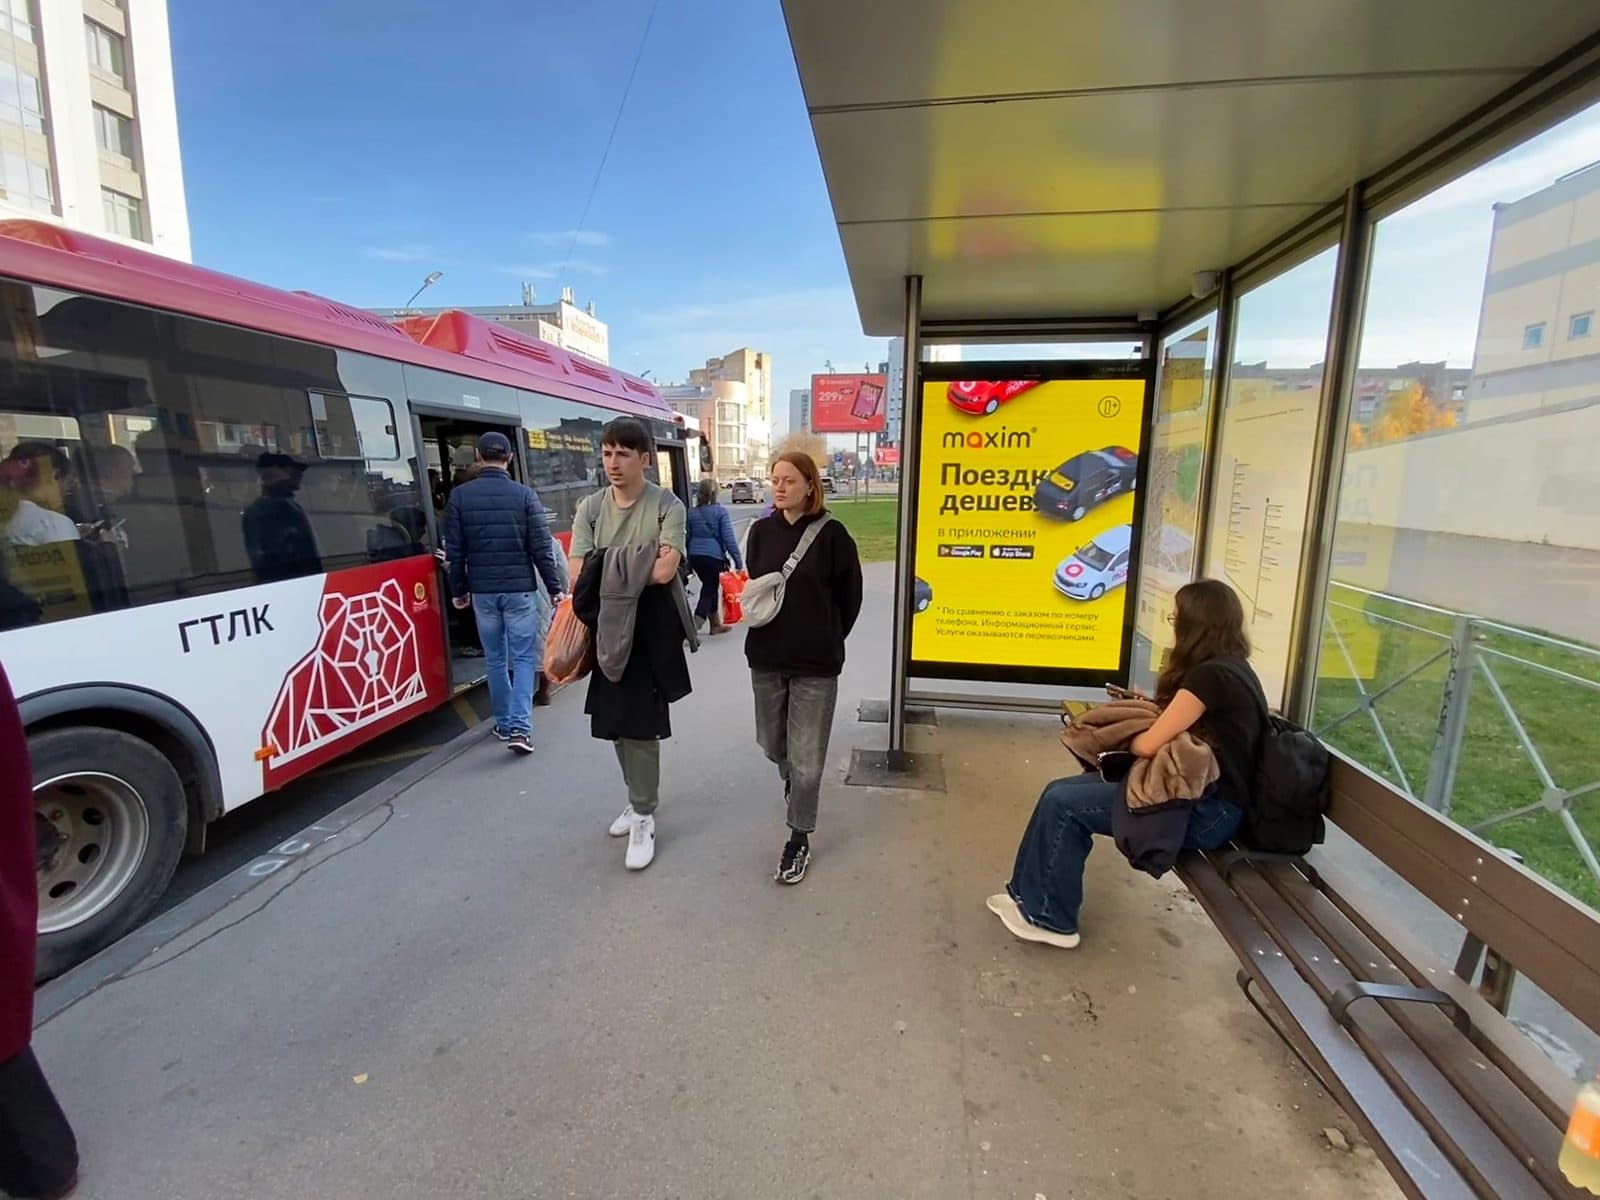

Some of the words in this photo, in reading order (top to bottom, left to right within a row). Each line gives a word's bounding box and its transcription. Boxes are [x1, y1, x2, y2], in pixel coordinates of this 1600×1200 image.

[943, 426, 1031, 448] maxim
[941, 463, 1048, 491] Поездк
[939, 494, 1039, 516] дешев
[938, 528, 945, 537] в
[949, 527, 1036, 540] приложении
[178, 604, 274, 653] ГТЛК
